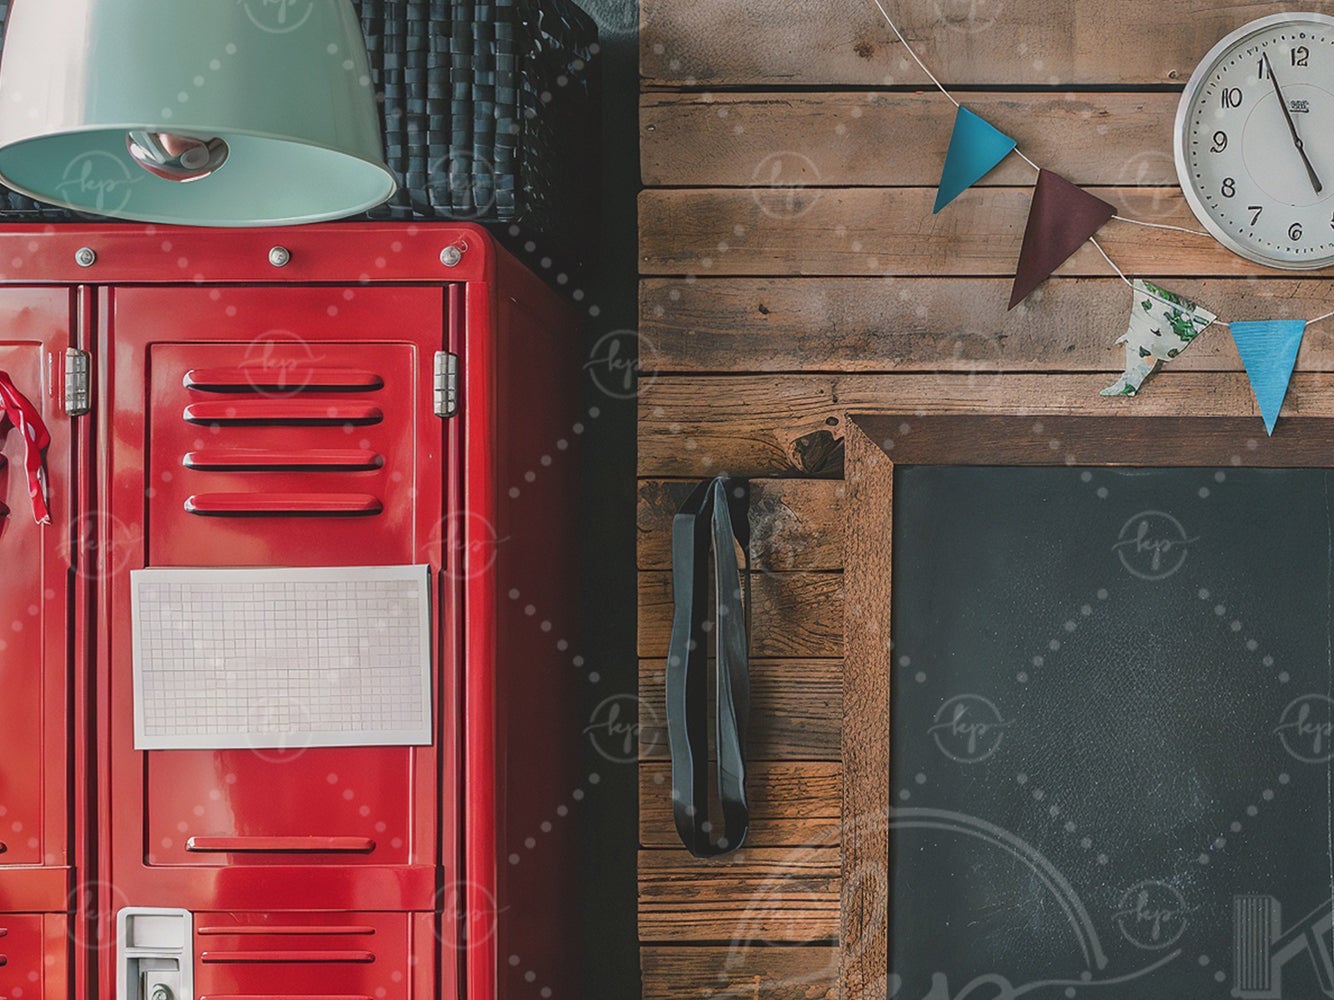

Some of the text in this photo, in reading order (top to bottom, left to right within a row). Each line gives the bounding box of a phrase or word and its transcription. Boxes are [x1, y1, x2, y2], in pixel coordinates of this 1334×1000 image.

[1290, 46, 1310, 67] 12
[1257, 58, 1271, 80] 11
[1221, 87, 1243, 109] 10
[1210, 131, 1228, 153] 9
[1221, 177, 1236, 198] 8
[1248, 206, 1263, 226] 7
[1288, 222, 1303, 241] 6
